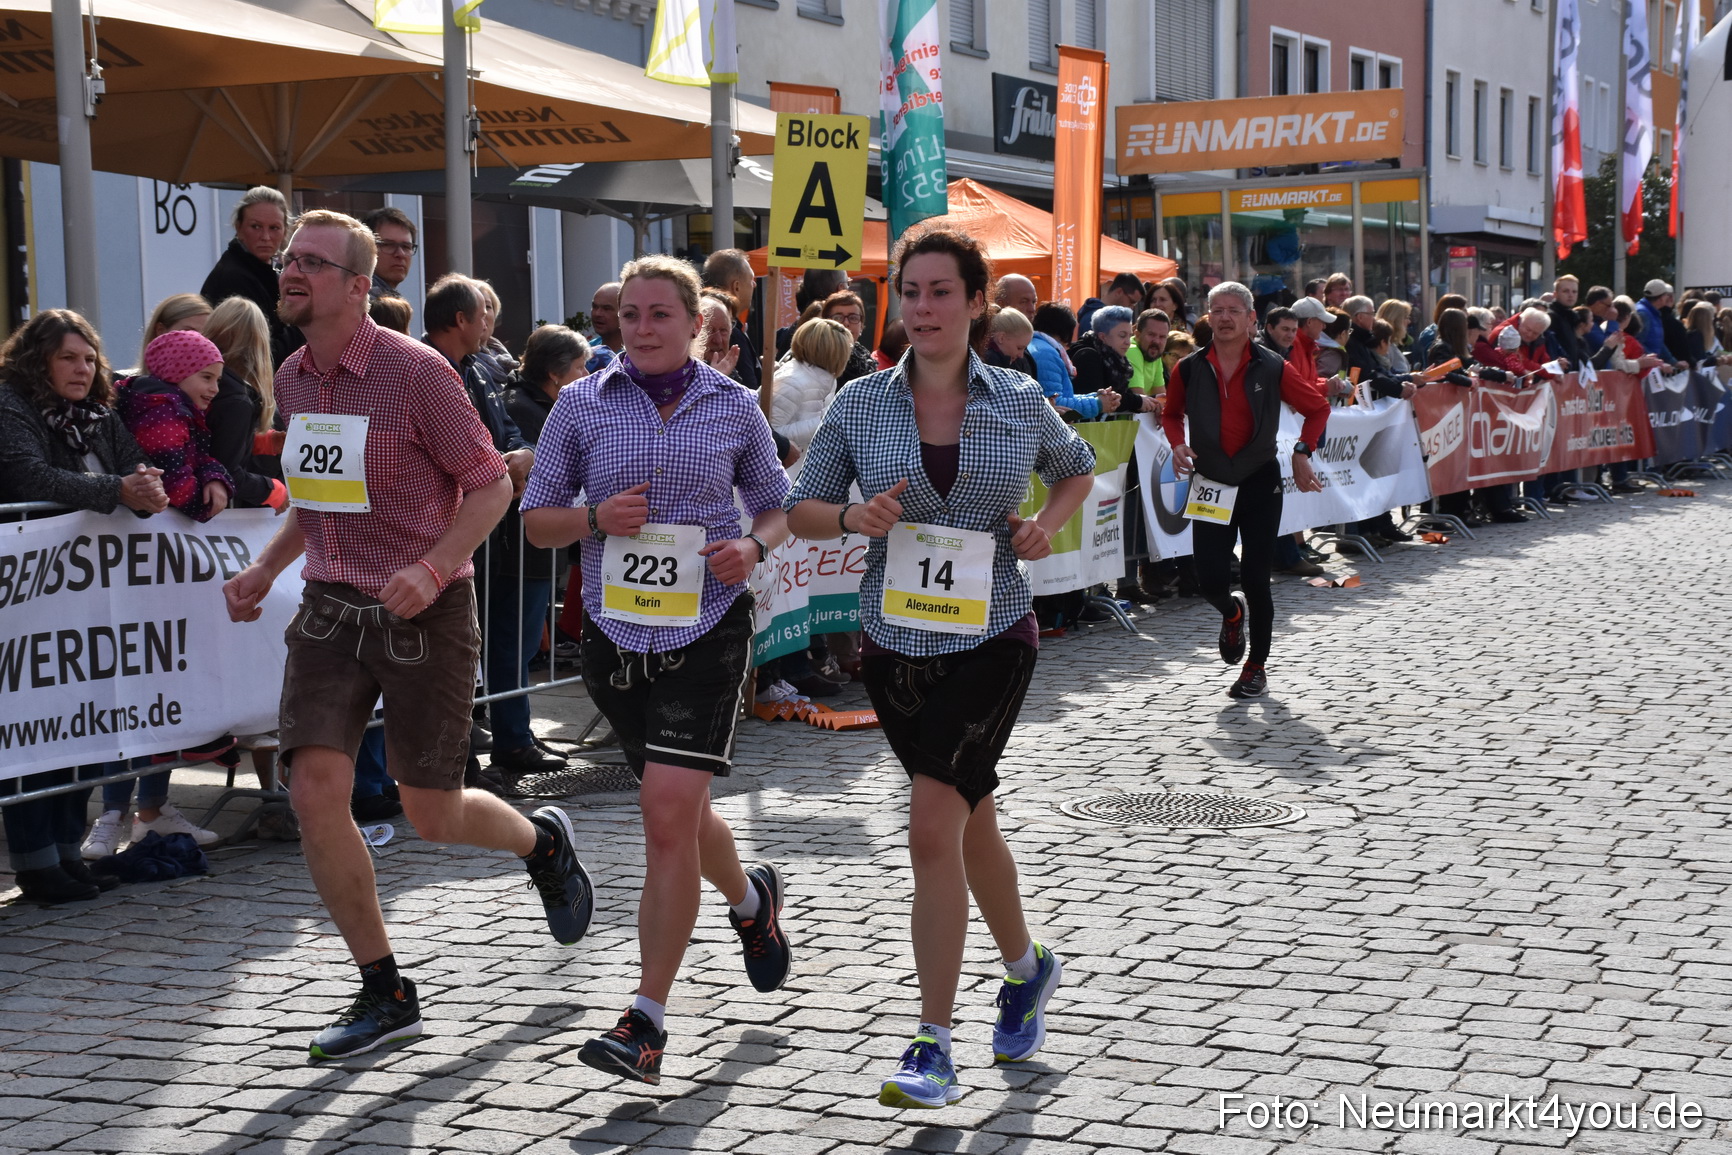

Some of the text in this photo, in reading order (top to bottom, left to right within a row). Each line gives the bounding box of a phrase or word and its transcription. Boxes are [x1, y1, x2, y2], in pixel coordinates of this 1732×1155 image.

[787, 119, 860, 149] Block
[789, 161, 843, 236] A
[299, 443, 344, 475] 292
[1197, 486, 1222, 504] 261
[1196, 505, 1216, 515] Michael
[639, 532, 675, 543] BOCK
[926, 535, 963, 548] BOCK
[622, 552, 679, 587] 223
[918, 557, 955, 592] 14
[634, 595, 661, 608] Karin
[905, 597, 961, 616] Alexandra
[0, 617, 188, 694] WERDEN!
